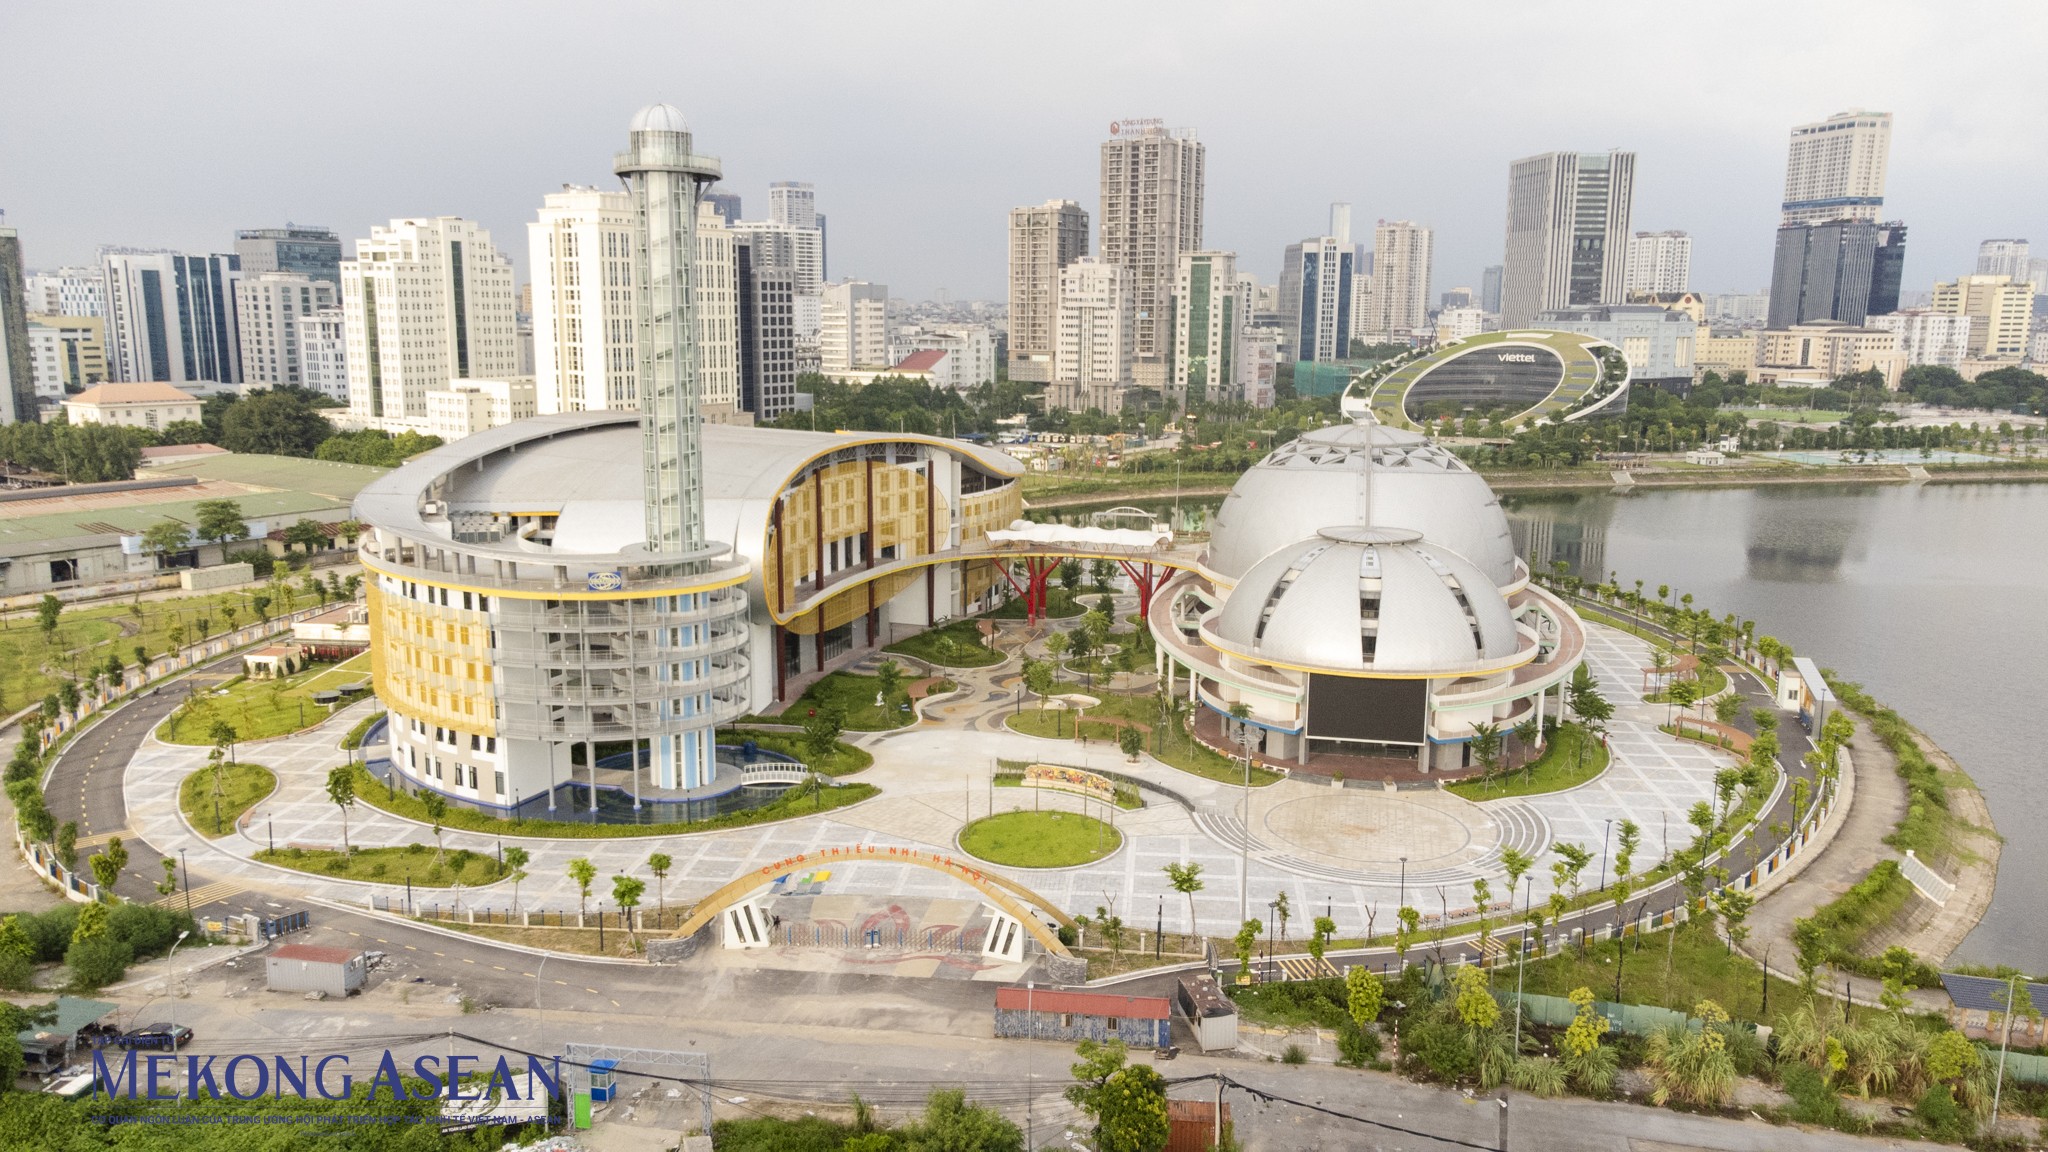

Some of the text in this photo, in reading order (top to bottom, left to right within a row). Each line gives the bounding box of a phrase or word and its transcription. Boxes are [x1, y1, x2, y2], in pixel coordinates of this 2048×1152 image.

[1498, 353, 1536, 362] viettel
[762, 854, 805, 875] CUNG
[889, 846, 917, 858] NHI
[933, 854, 952, 868] HÀ
